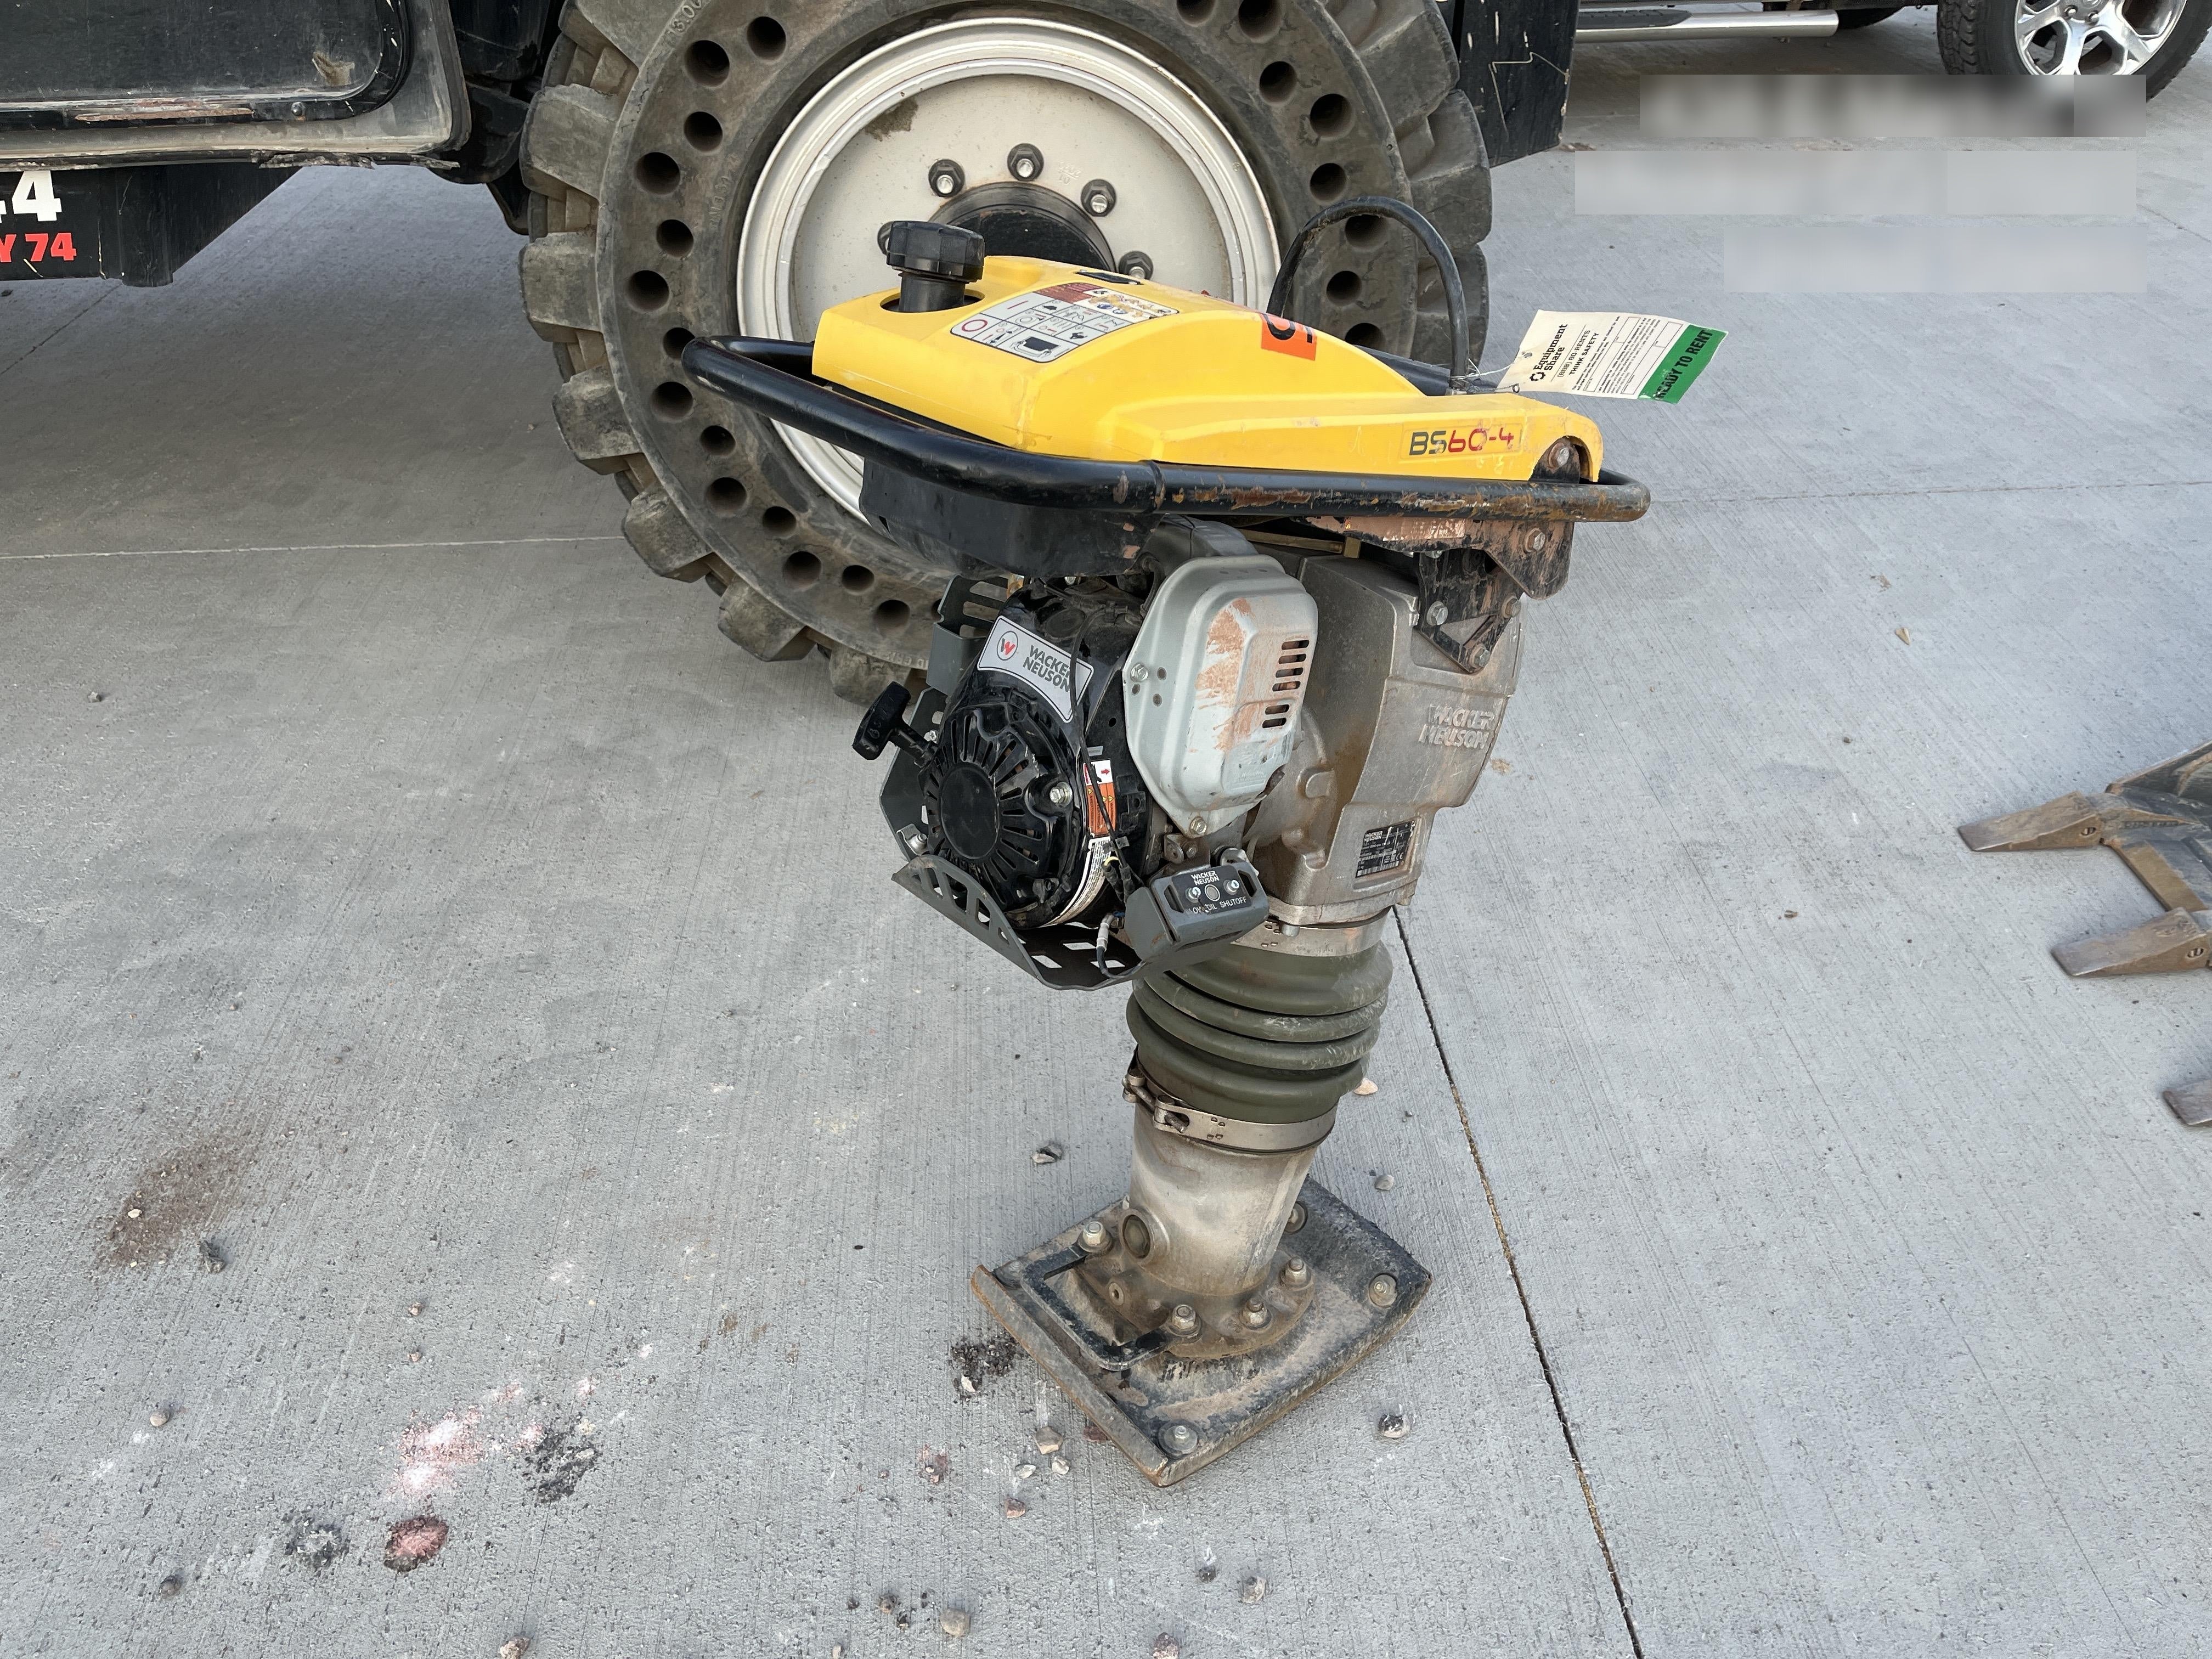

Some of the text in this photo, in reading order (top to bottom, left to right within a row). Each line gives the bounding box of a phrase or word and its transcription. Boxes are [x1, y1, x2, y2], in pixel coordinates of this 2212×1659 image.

[0, 171, 62, 223] 4
[25, 233, 77, 262] 74
[1533, 324, 1567, 370] Equipment
[1544, 347, 1565, 370] Share
[1569, 333, 1599, 375] THINK SAFETY
[1654, 329, 1713, 399] READY TO RENT
[1409, 427, 1514, 455] BS60-4
[1023, 656, 1070, 692] NEUSON
[1427, 703, 1496, 730] WACKER
[1418, 724, 1489, 749] NEUSON
[1190, 870, 1217, 880] WACKER
[1193, 876, 1220, 885] NEUSON
[1206, 903, 1218, 911] OIL
[1219, 896, 1247, 908] SHUTOFF
